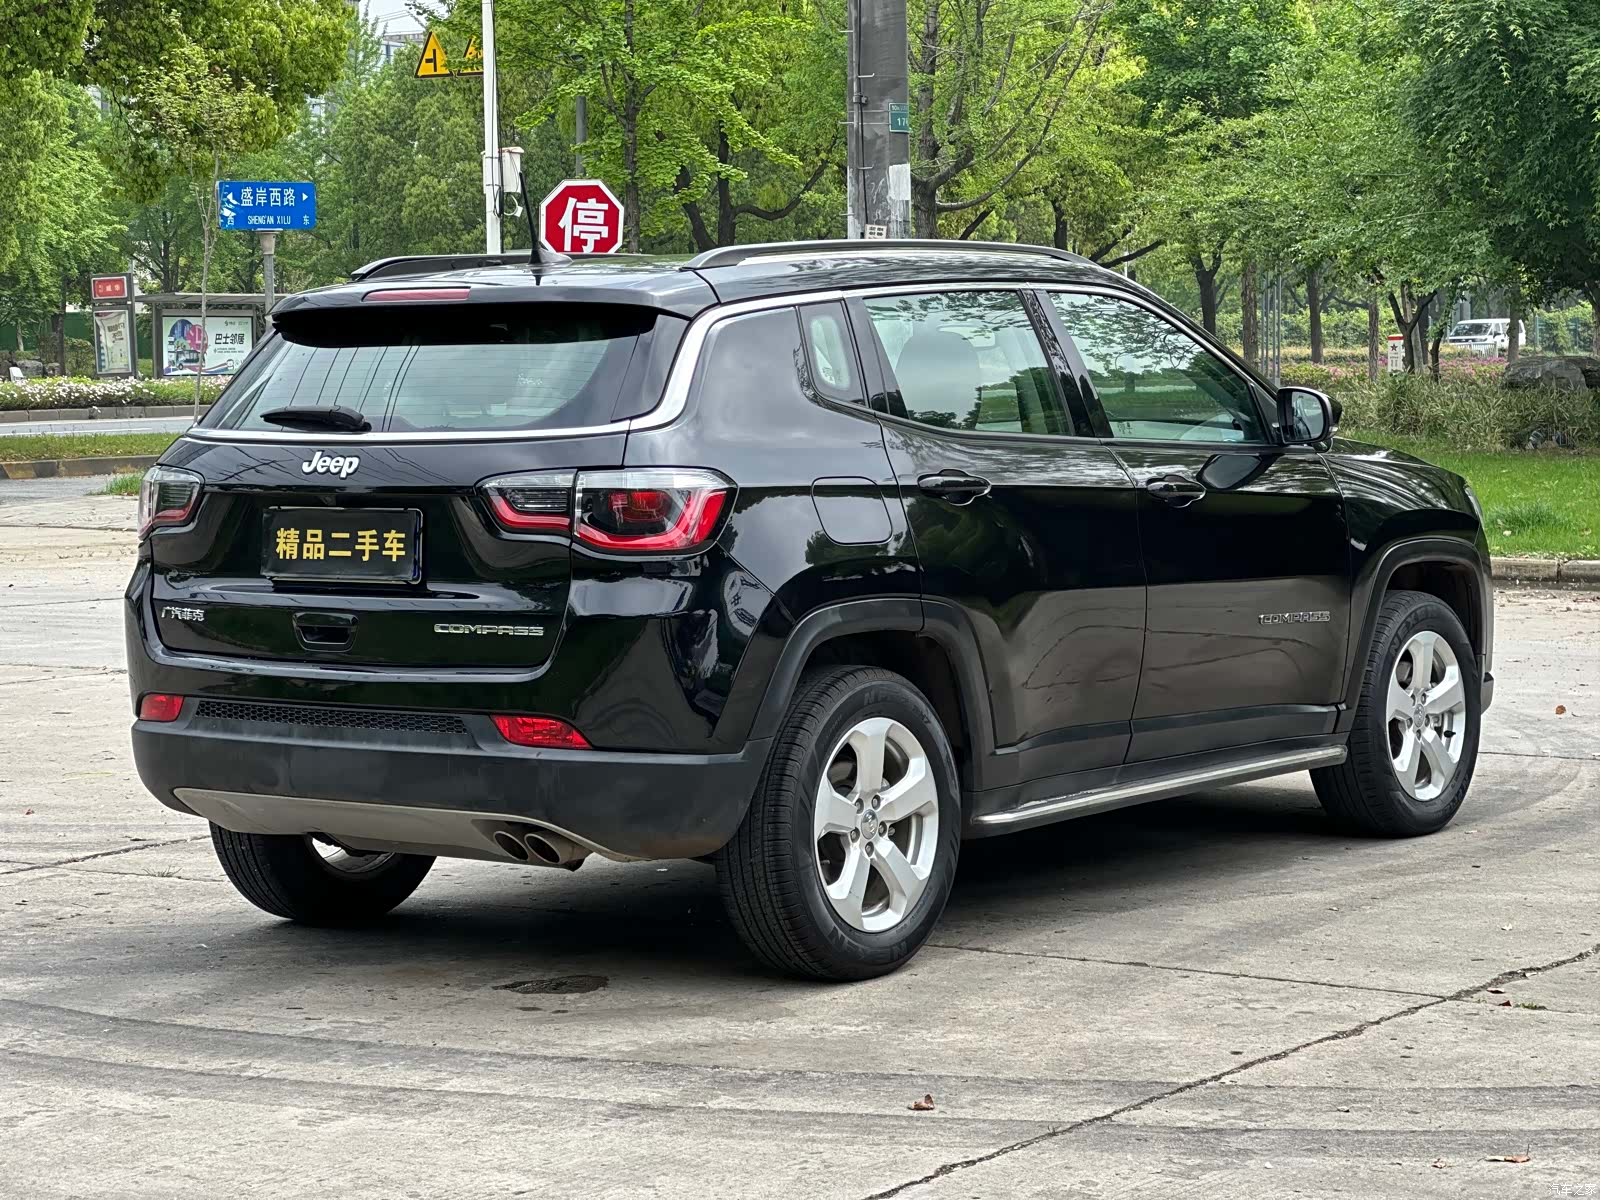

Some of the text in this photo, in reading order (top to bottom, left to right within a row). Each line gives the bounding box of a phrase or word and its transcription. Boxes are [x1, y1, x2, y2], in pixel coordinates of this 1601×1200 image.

[240, 186, 296, 207] 盛岸西路
[247, 215, 275, 225] SHENG'AN
[302, 214, 310, 225] 东
[557, 196, 609, 254] 停
[214, 332, 245, 345] 巴士邻居
[301, 450, 360, 479] Jeep
[275, 527, 406, 562] 精品二手车
[161, 606, 205, 622] 广汽菲克
[1259, 610, 1331, 625] COMPASS
[434, 623, 544, 636] COMPASS
